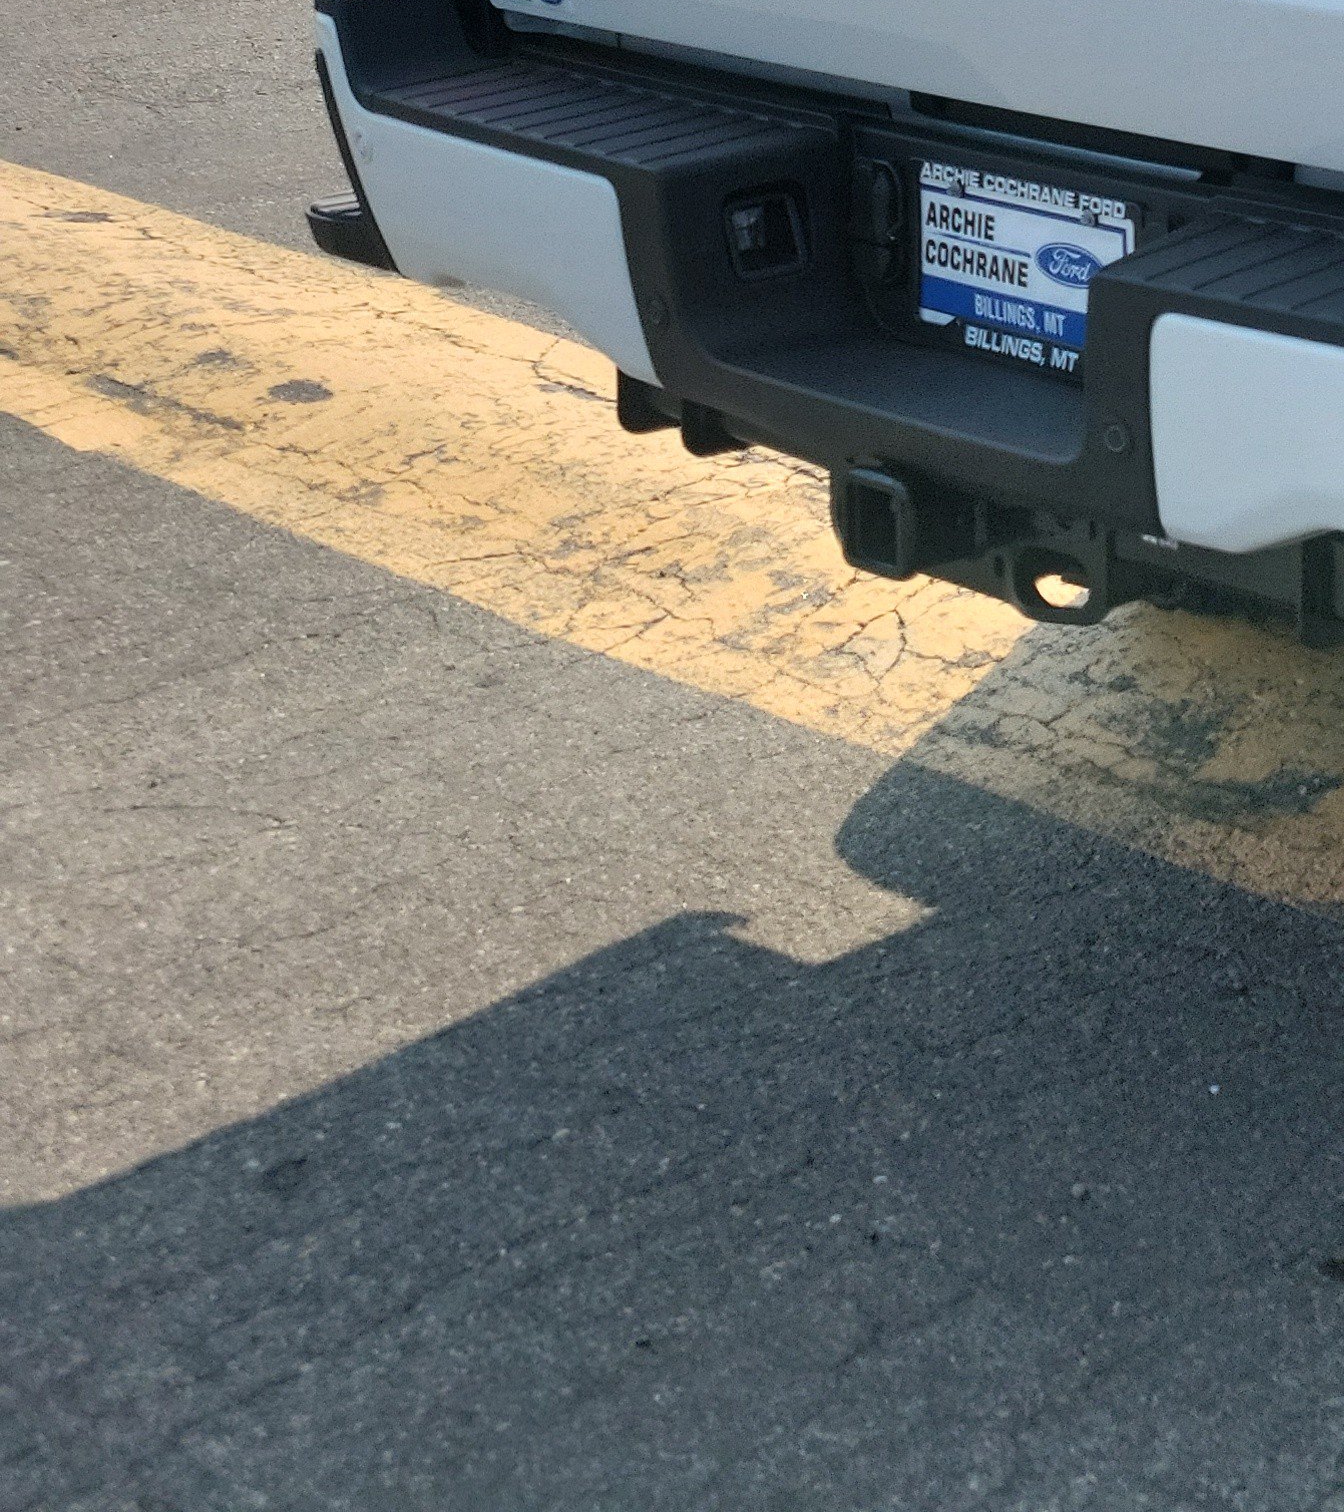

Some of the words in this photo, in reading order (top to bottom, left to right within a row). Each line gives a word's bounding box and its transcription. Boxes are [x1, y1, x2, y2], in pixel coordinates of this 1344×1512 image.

[920, 161, 980, 189] ARCHIE
[982, 173, 1076, 208] COCHRANE
[1078, 194, 1126, 219] FORD
[925, 200, 995, 242] ARCHIE
[924, 238, 1029, 289] COCHRANE
[1047, 249, 1091, 284] Ford
[1044, 310, 1067, 337] MT
[964, 325, 1046, 367] BILLINGS,
[1049, 348, 1079, 373] MT
